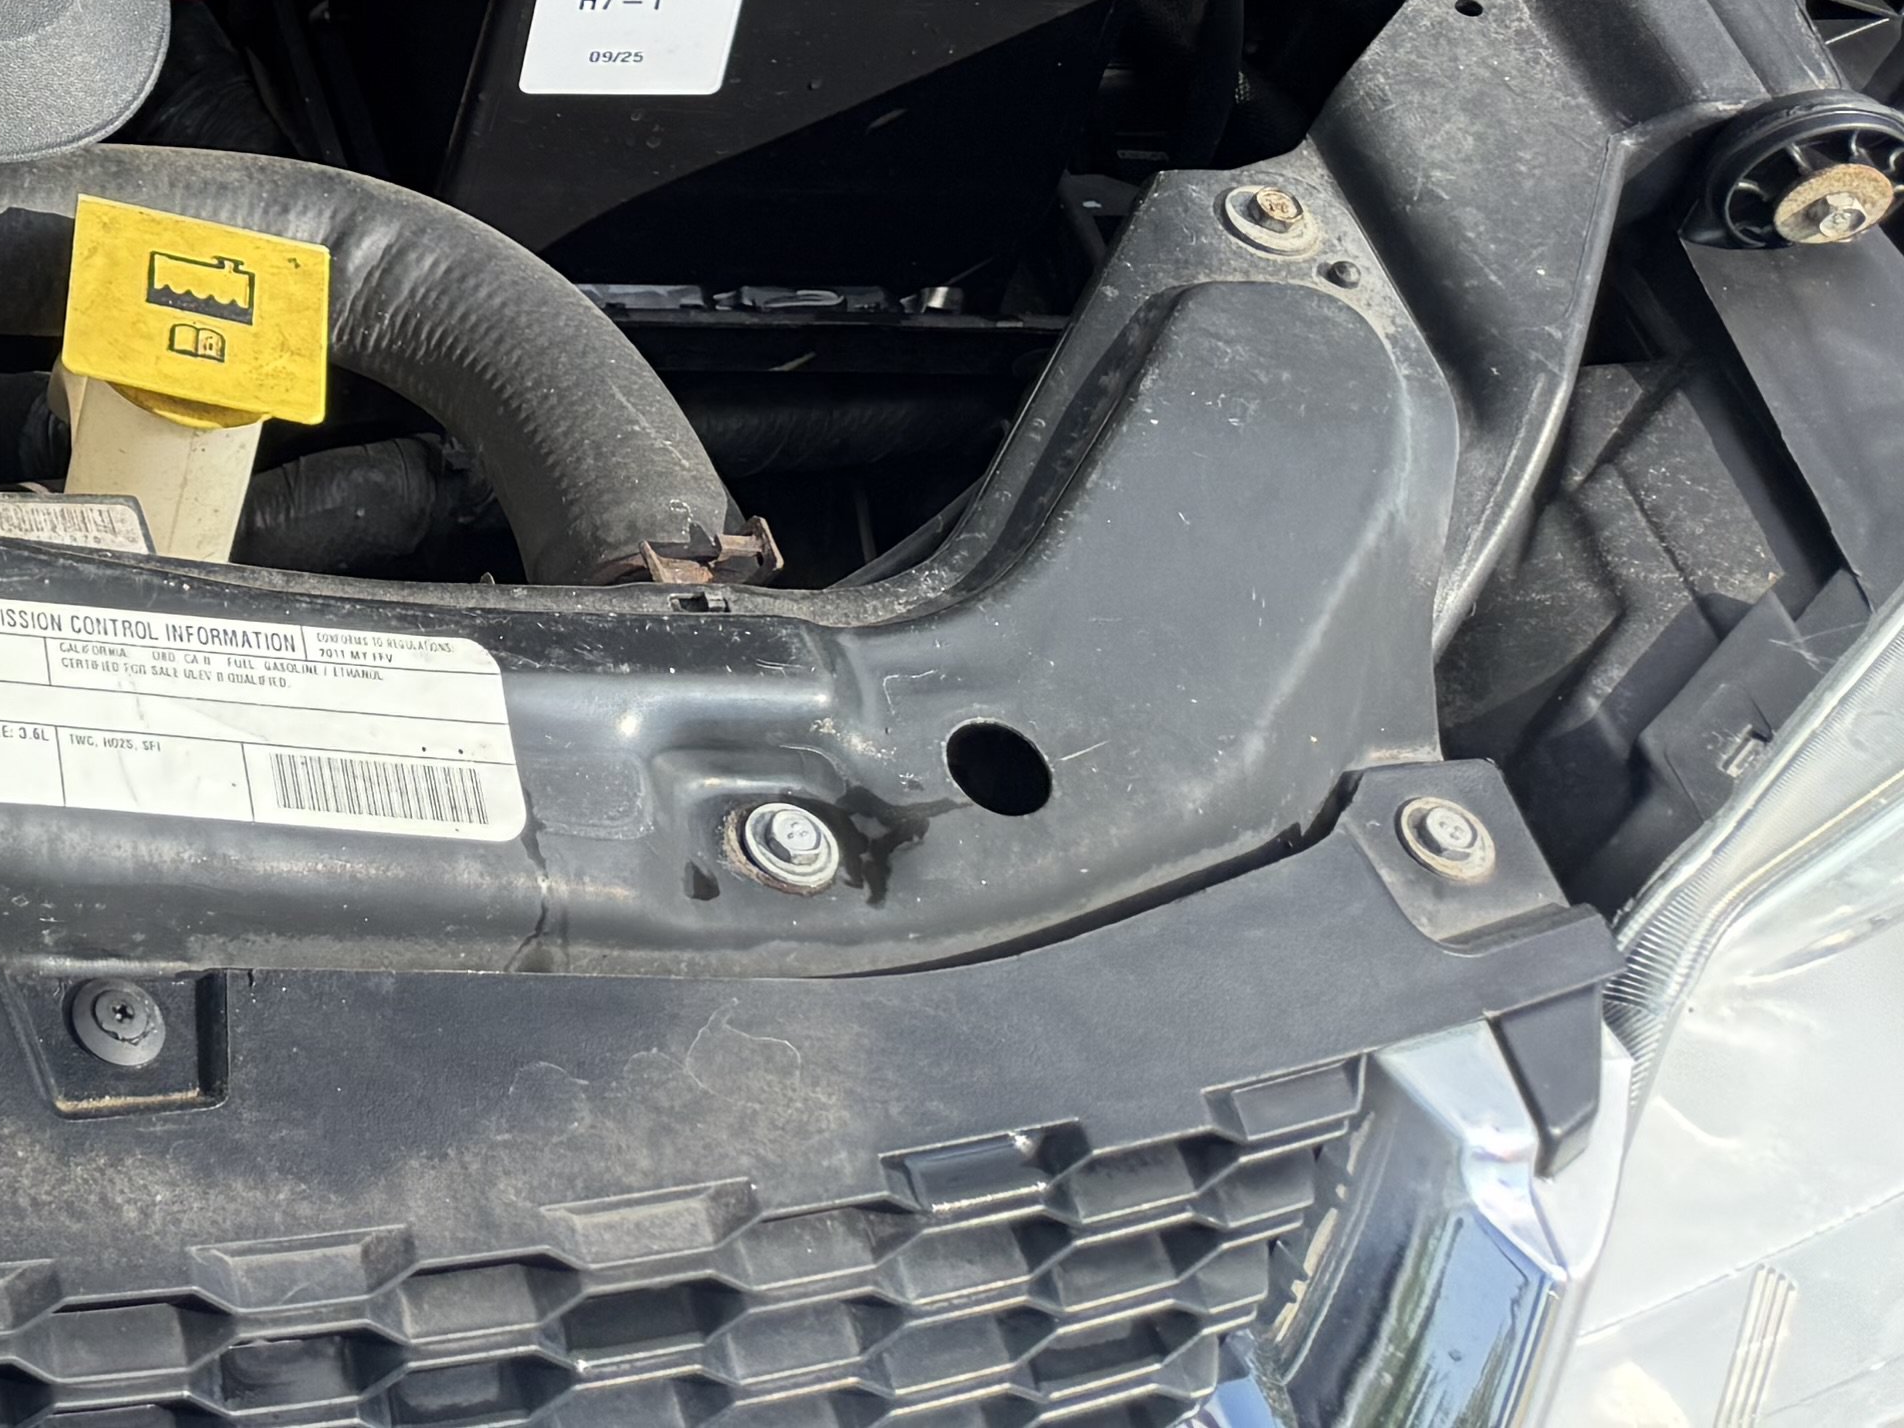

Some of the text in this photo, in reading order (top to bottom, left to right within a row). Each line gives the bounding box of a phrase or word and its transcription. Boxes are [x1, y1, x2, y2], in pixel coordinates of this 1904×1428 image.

[588, 51, 644, 63] 09/25
[71, 615, 158, 641] CONTROL
[165, 622, 296, 653] INFORMATION
[18, 726, 50, 742] 3.6L
